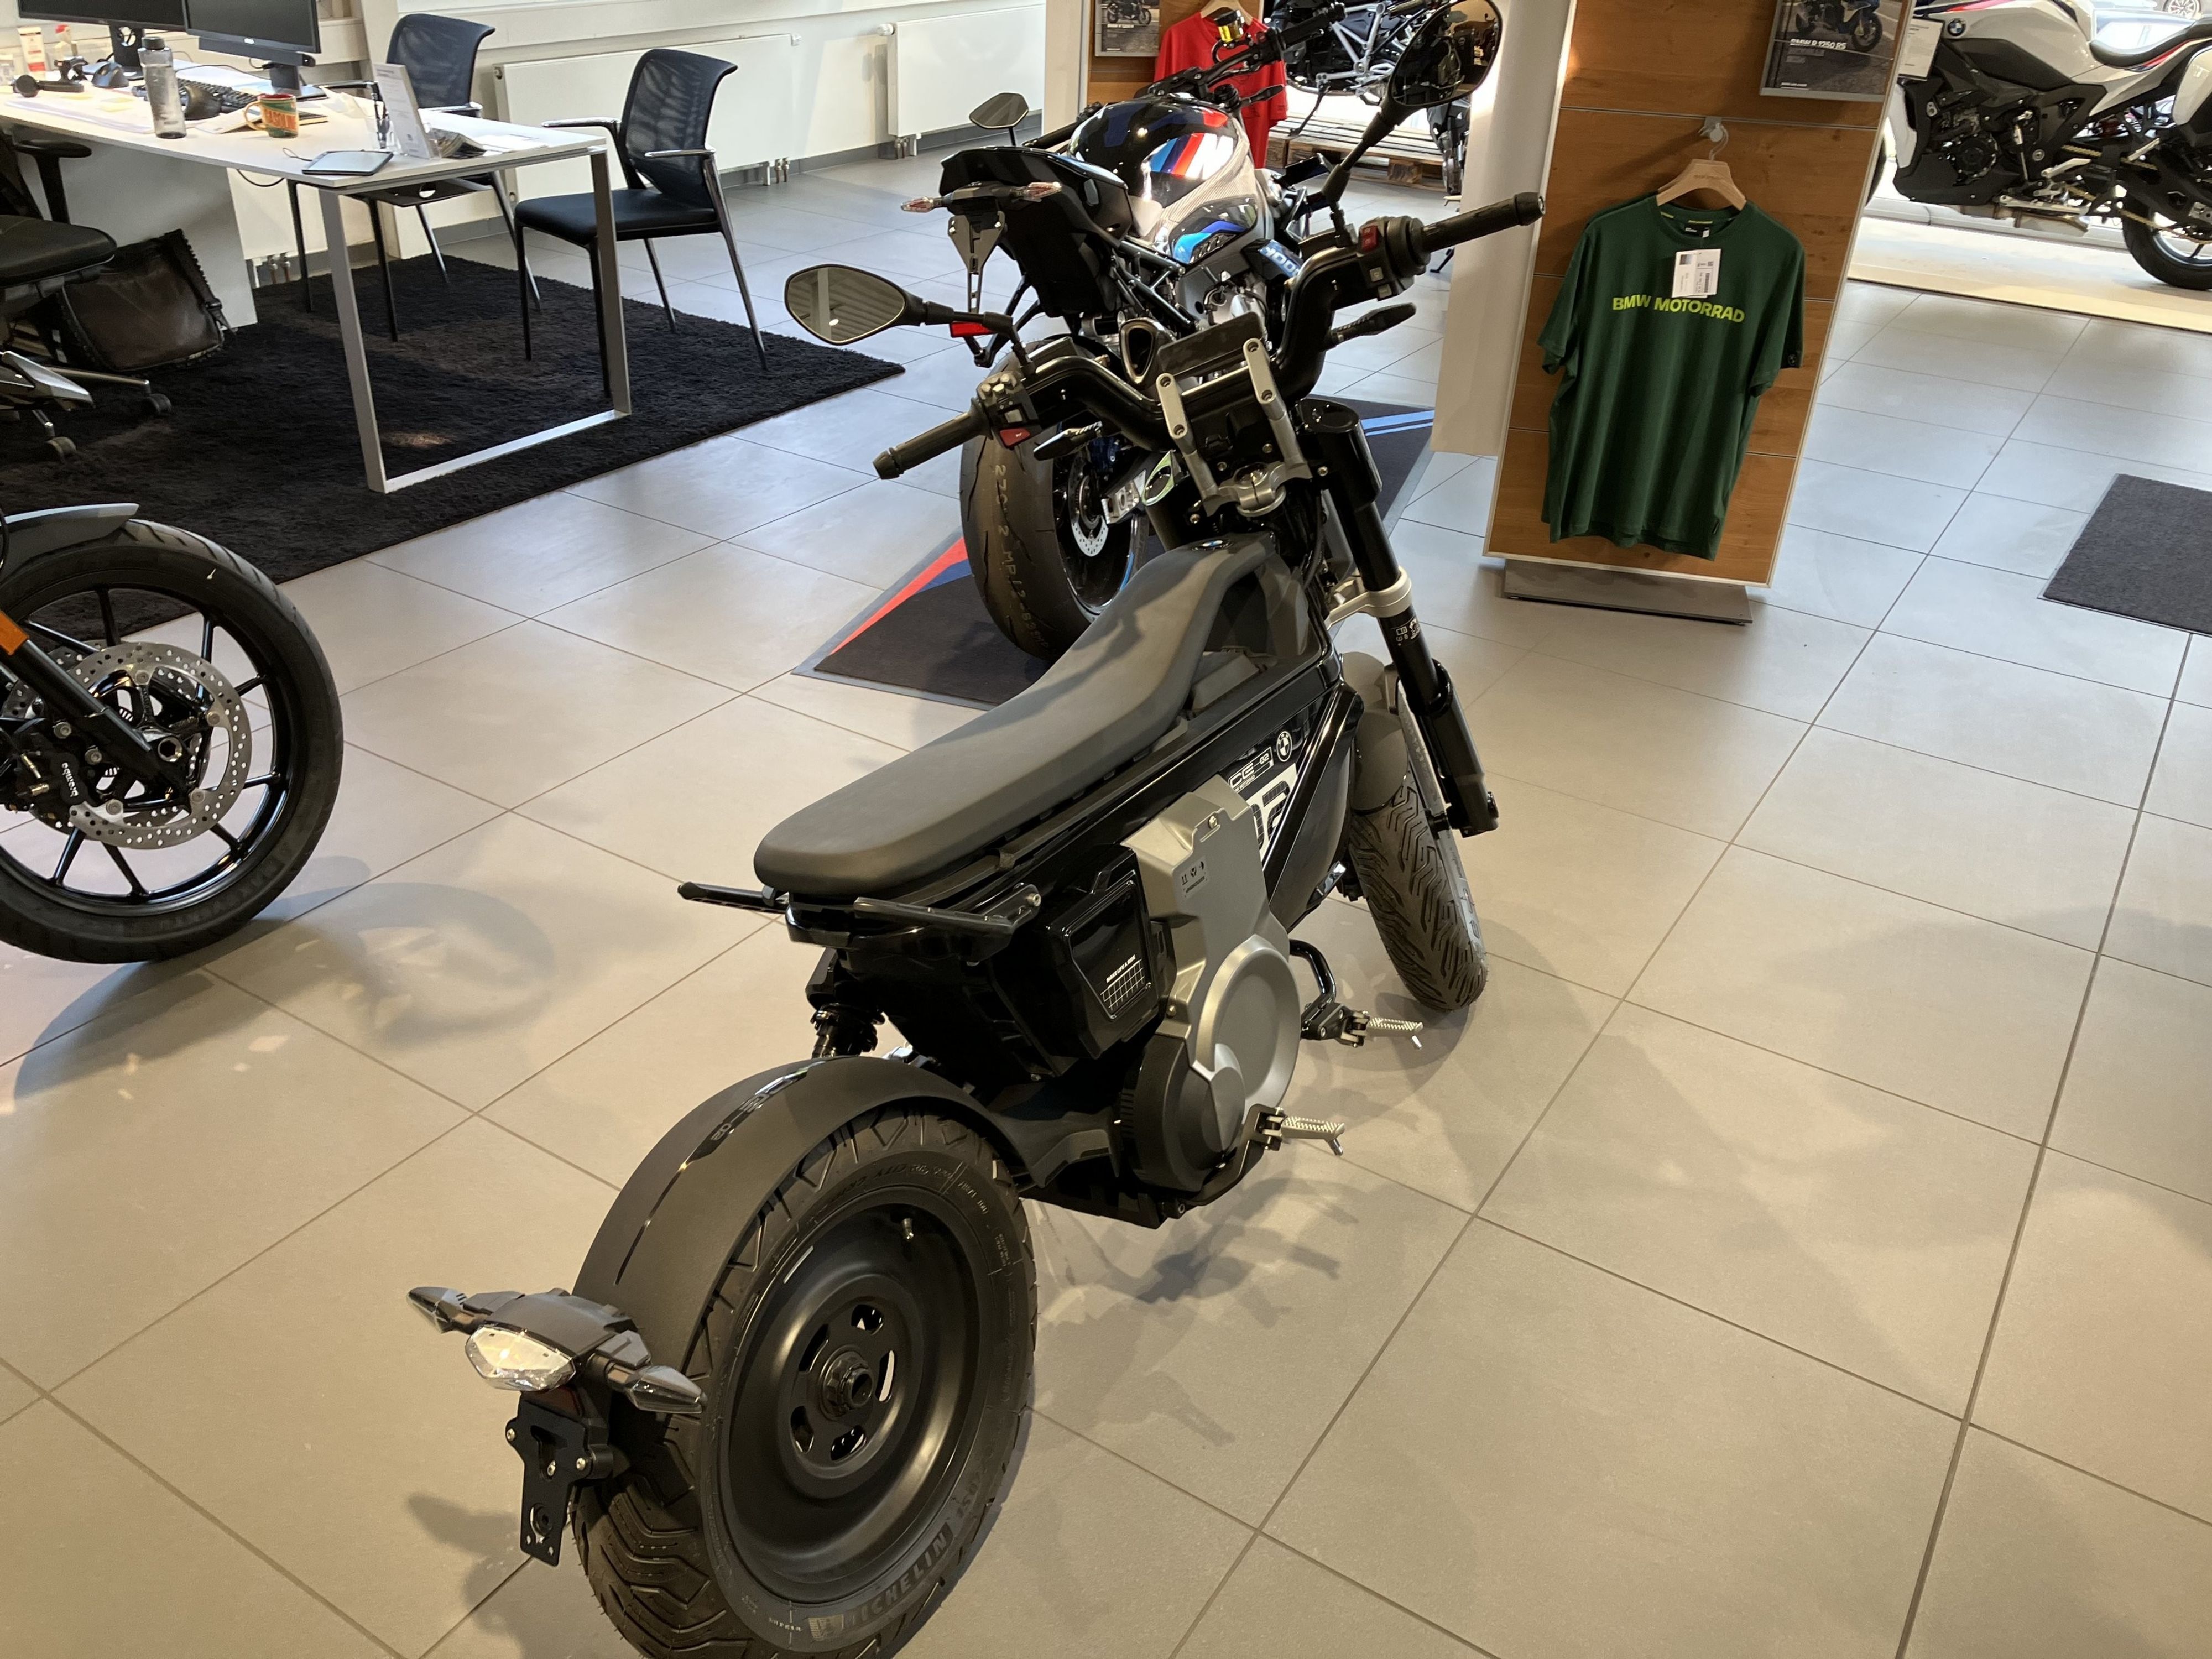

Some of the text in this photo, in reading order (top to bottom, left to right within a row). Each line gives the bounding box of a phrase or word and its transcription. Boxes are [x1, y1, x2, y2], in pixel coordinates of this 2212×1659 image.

[1613, 294, 1745, 322] BMW MOTORRAD
[61, 762, 79, 797] brembo
[1229, 752, 1270, 788] CE 02
[1106, 970, 1118, 983] MAKE
[1127, 954, 1136, 965] RIDE
